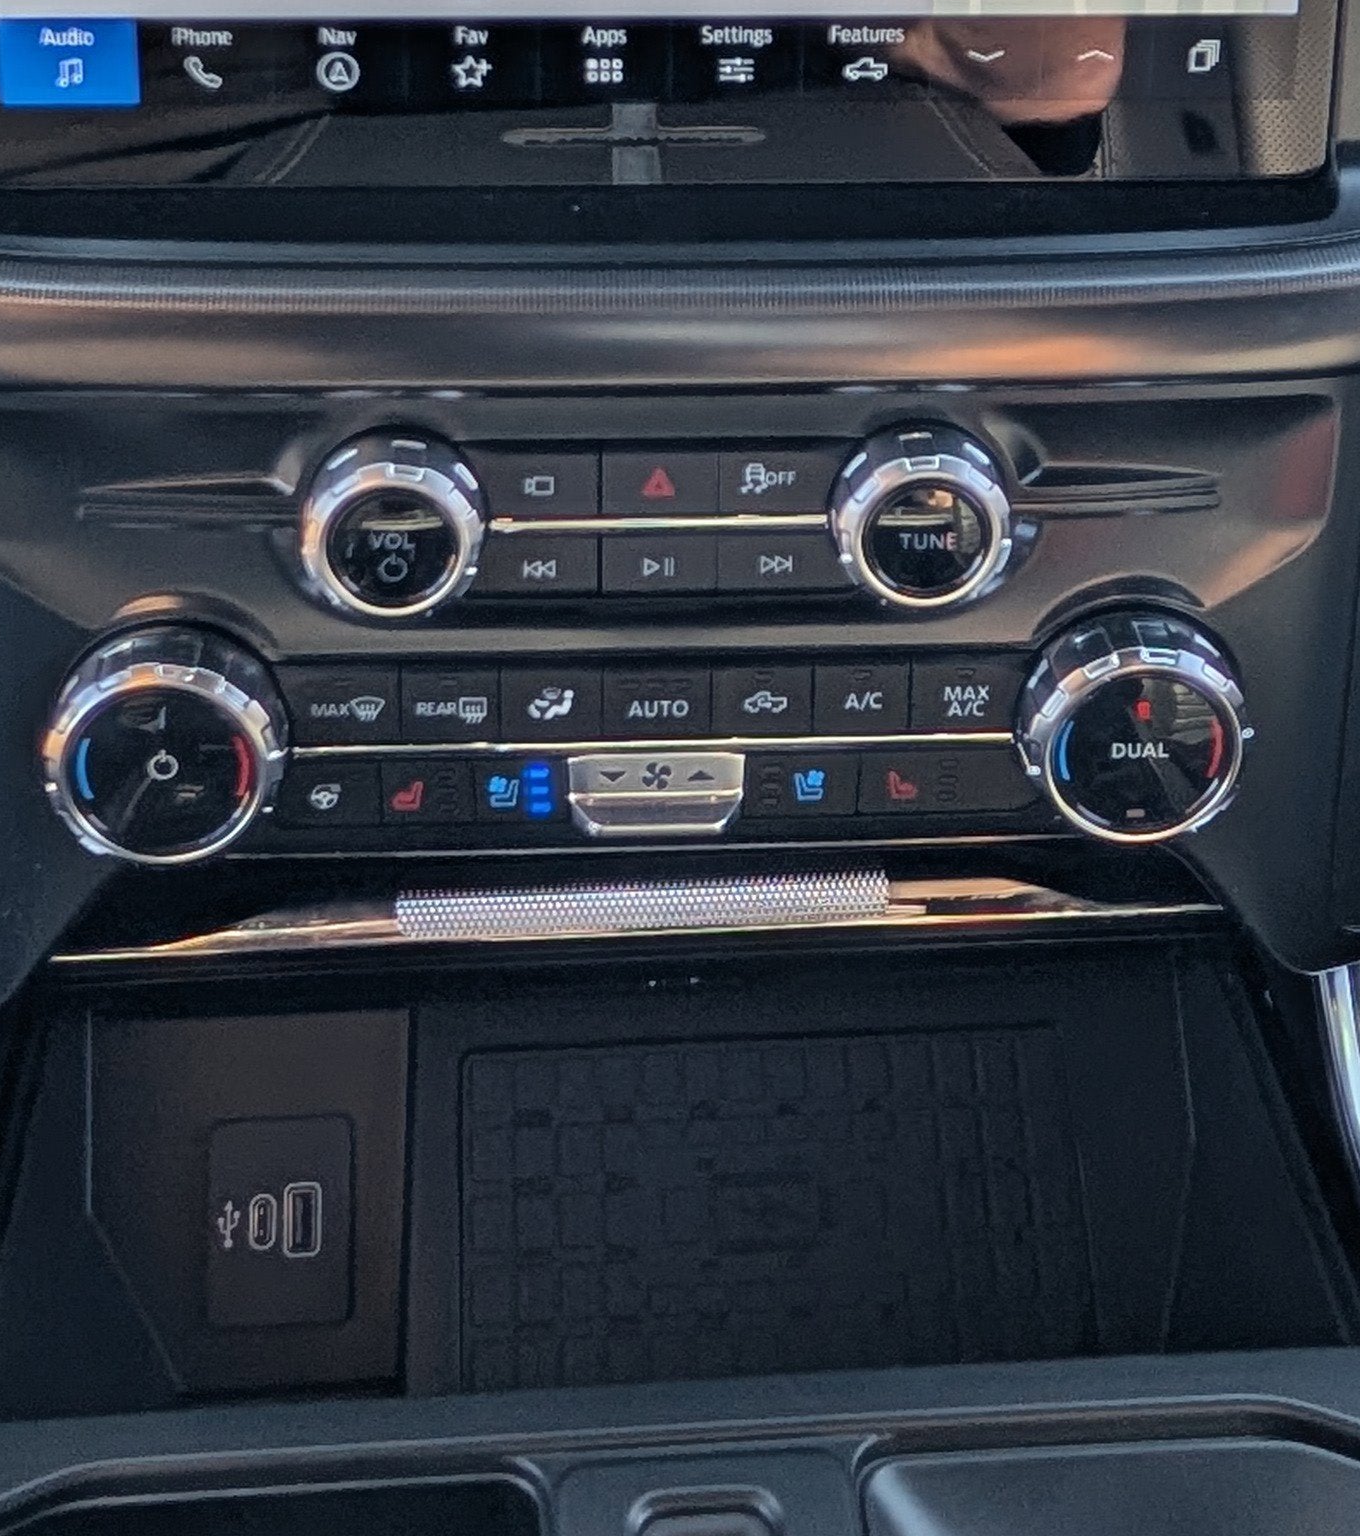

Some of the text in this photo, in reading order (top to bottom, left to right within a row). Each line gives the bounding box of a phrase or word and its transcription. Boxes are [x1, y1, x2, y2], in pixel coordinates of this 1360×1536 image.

[39, 26, 95, 48] Audio
[171, 26, 233, 48] Phone
[318, 26, 356, 47] Nav
[453, 26, 489, 47] Fav
[582, 26, 628, 51] Apps
[701, 24, 773, 47] Settings
[827, 24, 906, 45] Features
[765, 470, 796, 487] OFF
[369, 531, 417, 550] VOL
[898, 532, 959, 551] TUNE
[844, 691, 883, 712] A/C
[943, 685, 990, 703] MAX
[310, 702, 349, 718] MAX
[415, 701, 457, 716] REAR
[627, 699, 690, 719] AUTO
[947, 699, 986, 719] A/C
[1110, 741, 1170, 761] DUAL
